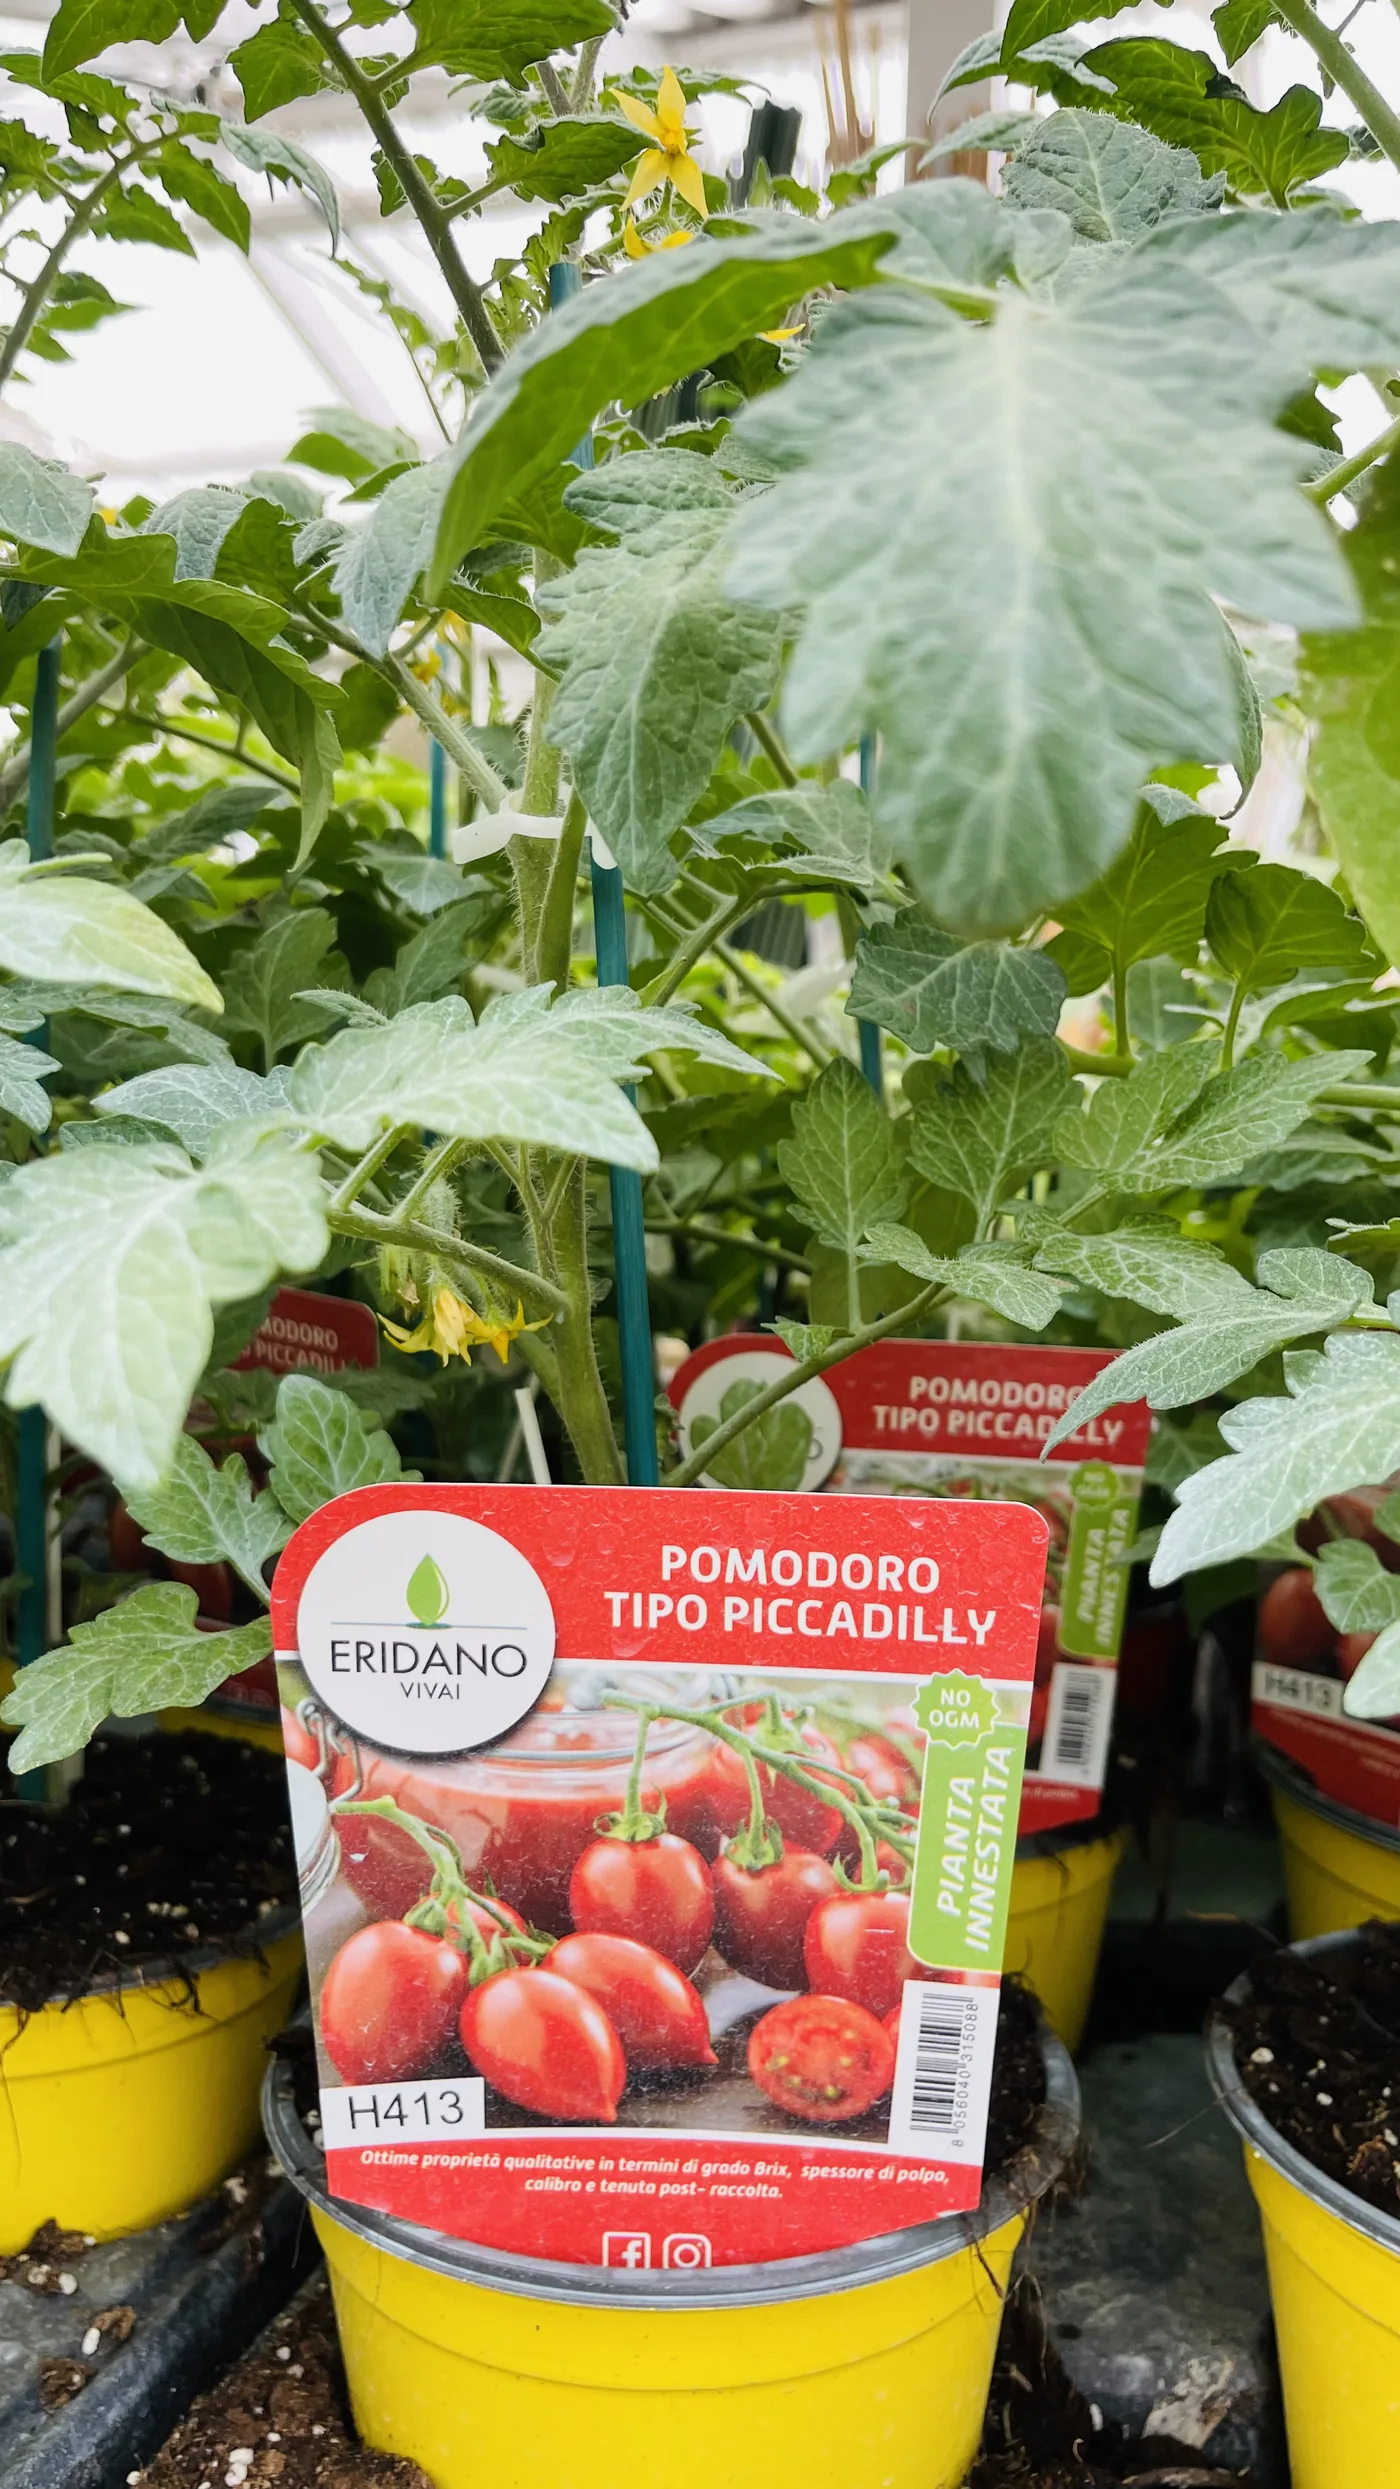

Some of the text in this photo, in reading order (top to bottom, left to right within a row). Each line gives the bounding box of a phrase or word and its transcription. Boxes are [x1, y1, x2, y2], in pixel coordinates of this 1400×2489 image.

[257, 1315, 339, 1353] MODORO
[873, 1405, 1125, 1446] TIPO PICCADLLY
[661, 1545, 940, 1594] POMODORO
[603, 1591, 997, 1646] TIPO PICCADILLY
[330, 1640, 528, 1677] ERIDANO
[399, 1681, 461, 1700] VIVAI
[940, 1688, 971, 1707] NO
[928, 1709, 980, 1728] OGM
[937, 1776, 976, 1917] PIANTA
[964, 1746, 1013, 1952] INNESTATA
[348, 2090, 464, 2129] H413
[360, 2150, 419, 2166] Ottime
[503, 2153, 596, 2173] qualitative
[598, 2155, 614, 2172] in
[618, 2156, 678, 2173] termini
[681, 2157, 699, 2174] di
[700, 2159, 751, 2178] grado
[754, 2160, 793, 2179] Brix,
[800, 2165, 874, 2182] spessore
[878, 2165, 895, 2180] di
[897, 2167, 950, 2185] polpa,
[524, 2176, 784, 2199] calibro e tenuta post- raccolta.
